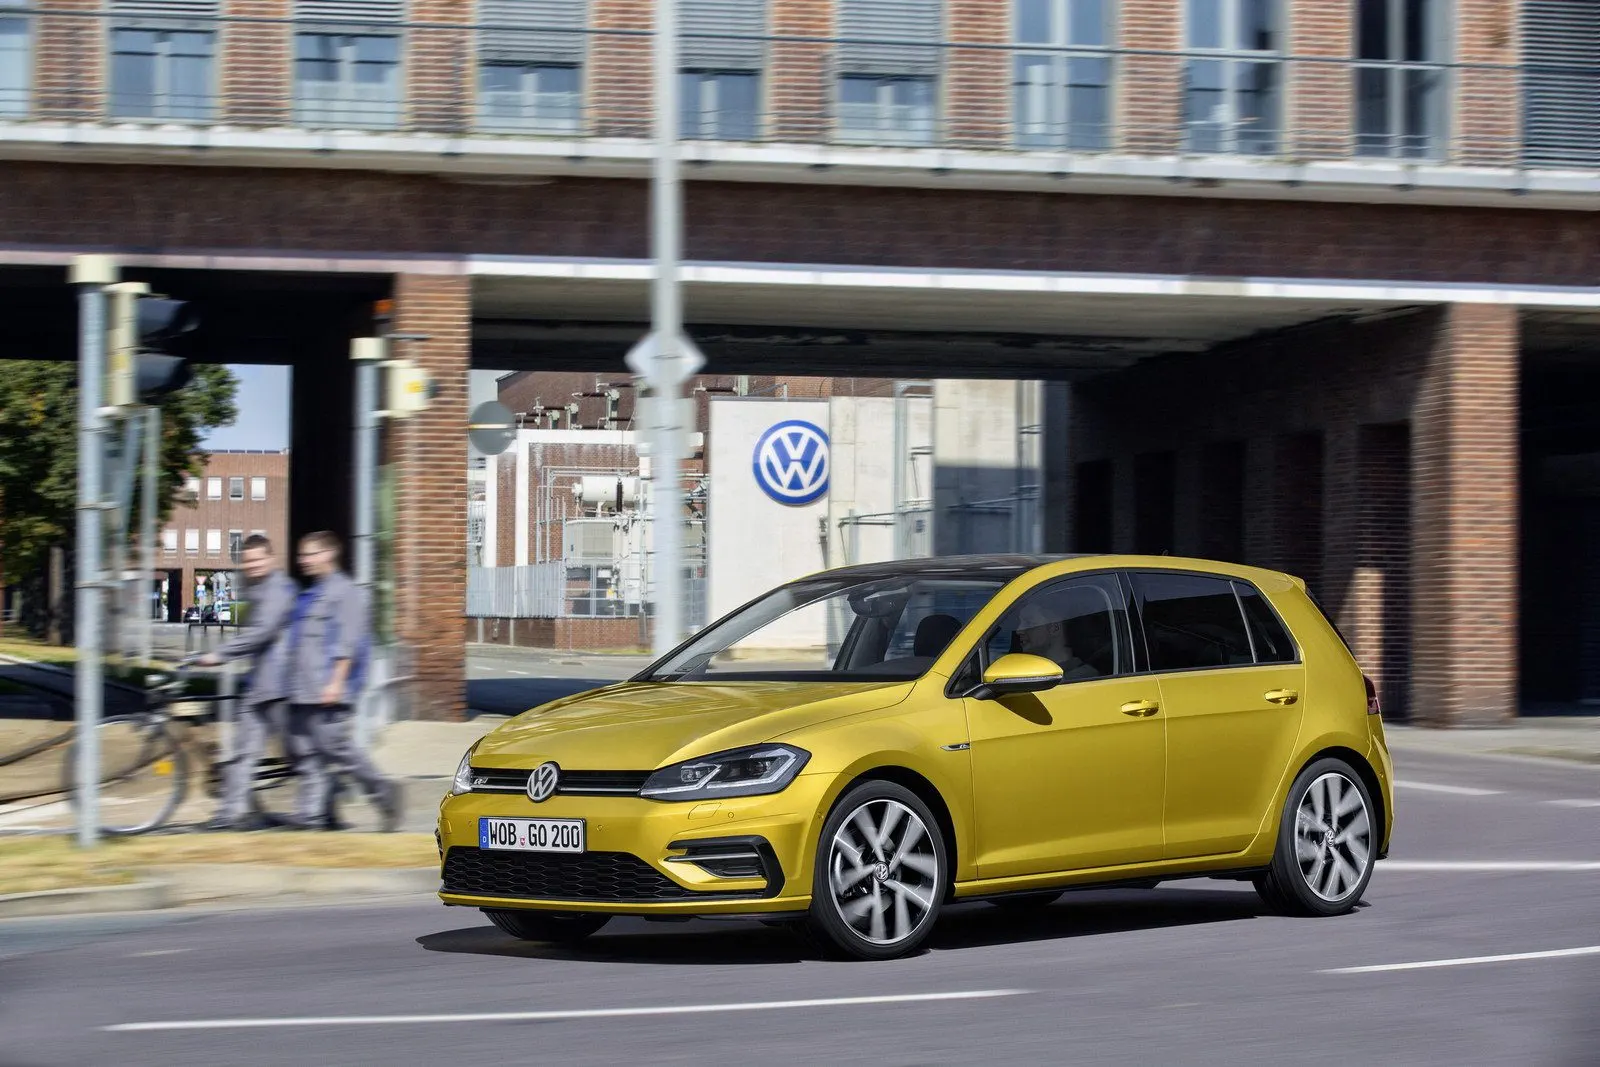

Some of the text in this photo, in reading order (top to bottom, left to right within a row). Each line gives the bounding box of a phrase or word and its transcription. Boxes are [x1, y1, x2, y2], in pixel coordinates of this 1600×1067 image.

[760, 426, 829, 497] VW
[527, 763, 557, 800] VW
[489, 822, 580, 848] WOB GO 200
